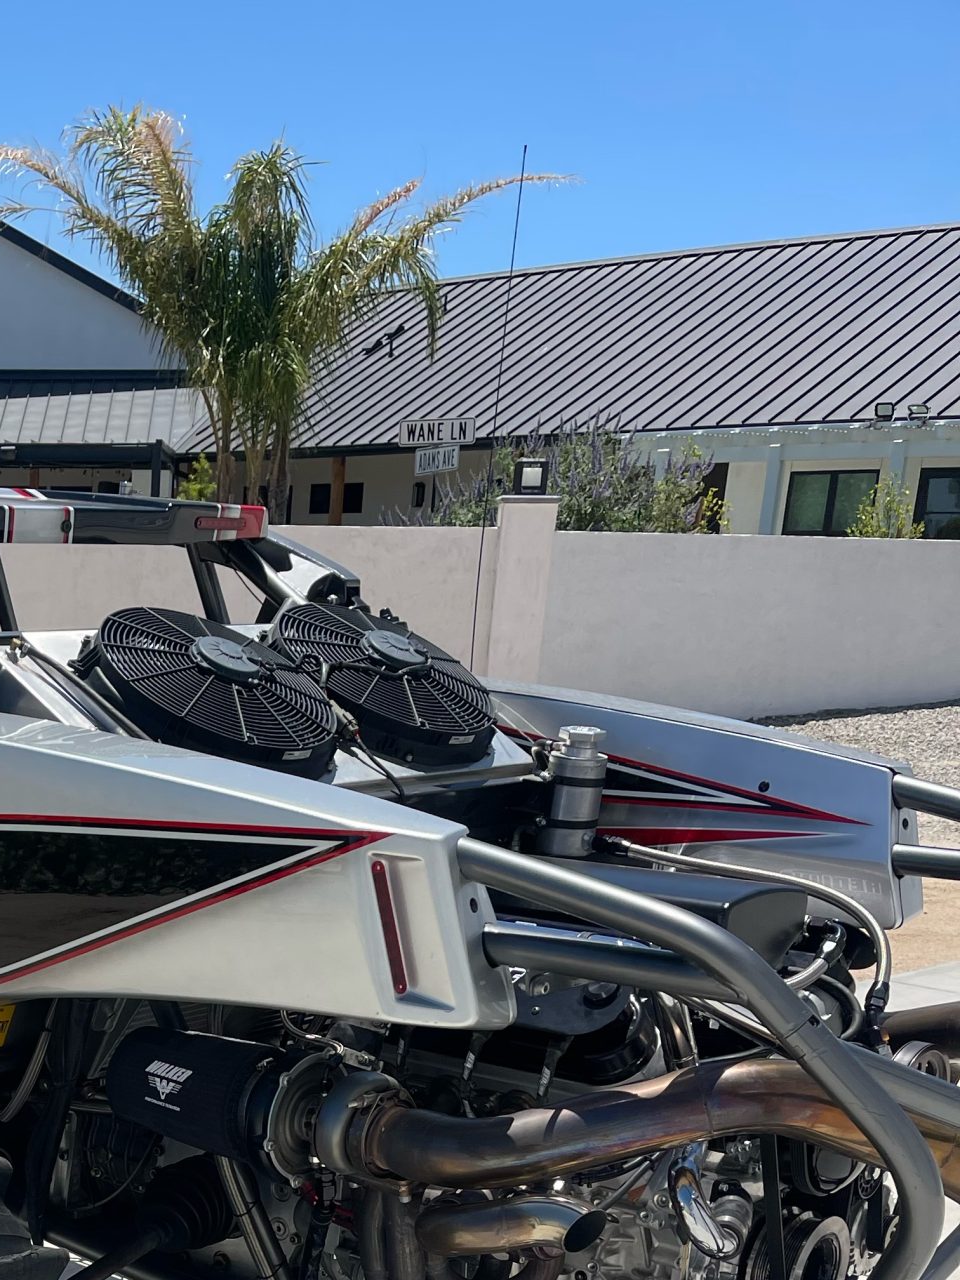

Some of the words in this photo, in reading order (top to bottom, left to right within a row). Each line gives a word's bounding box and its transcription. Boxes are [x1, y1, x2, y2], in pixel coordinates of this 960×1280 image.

[406, 422, 444, 442] WANE
[450, 421, 467, 441] LN
[418, 450, 440, 473] ADAMS
[441, 448, 456, 468] AVE
[144, 1060, 193, 1083] WALKER
